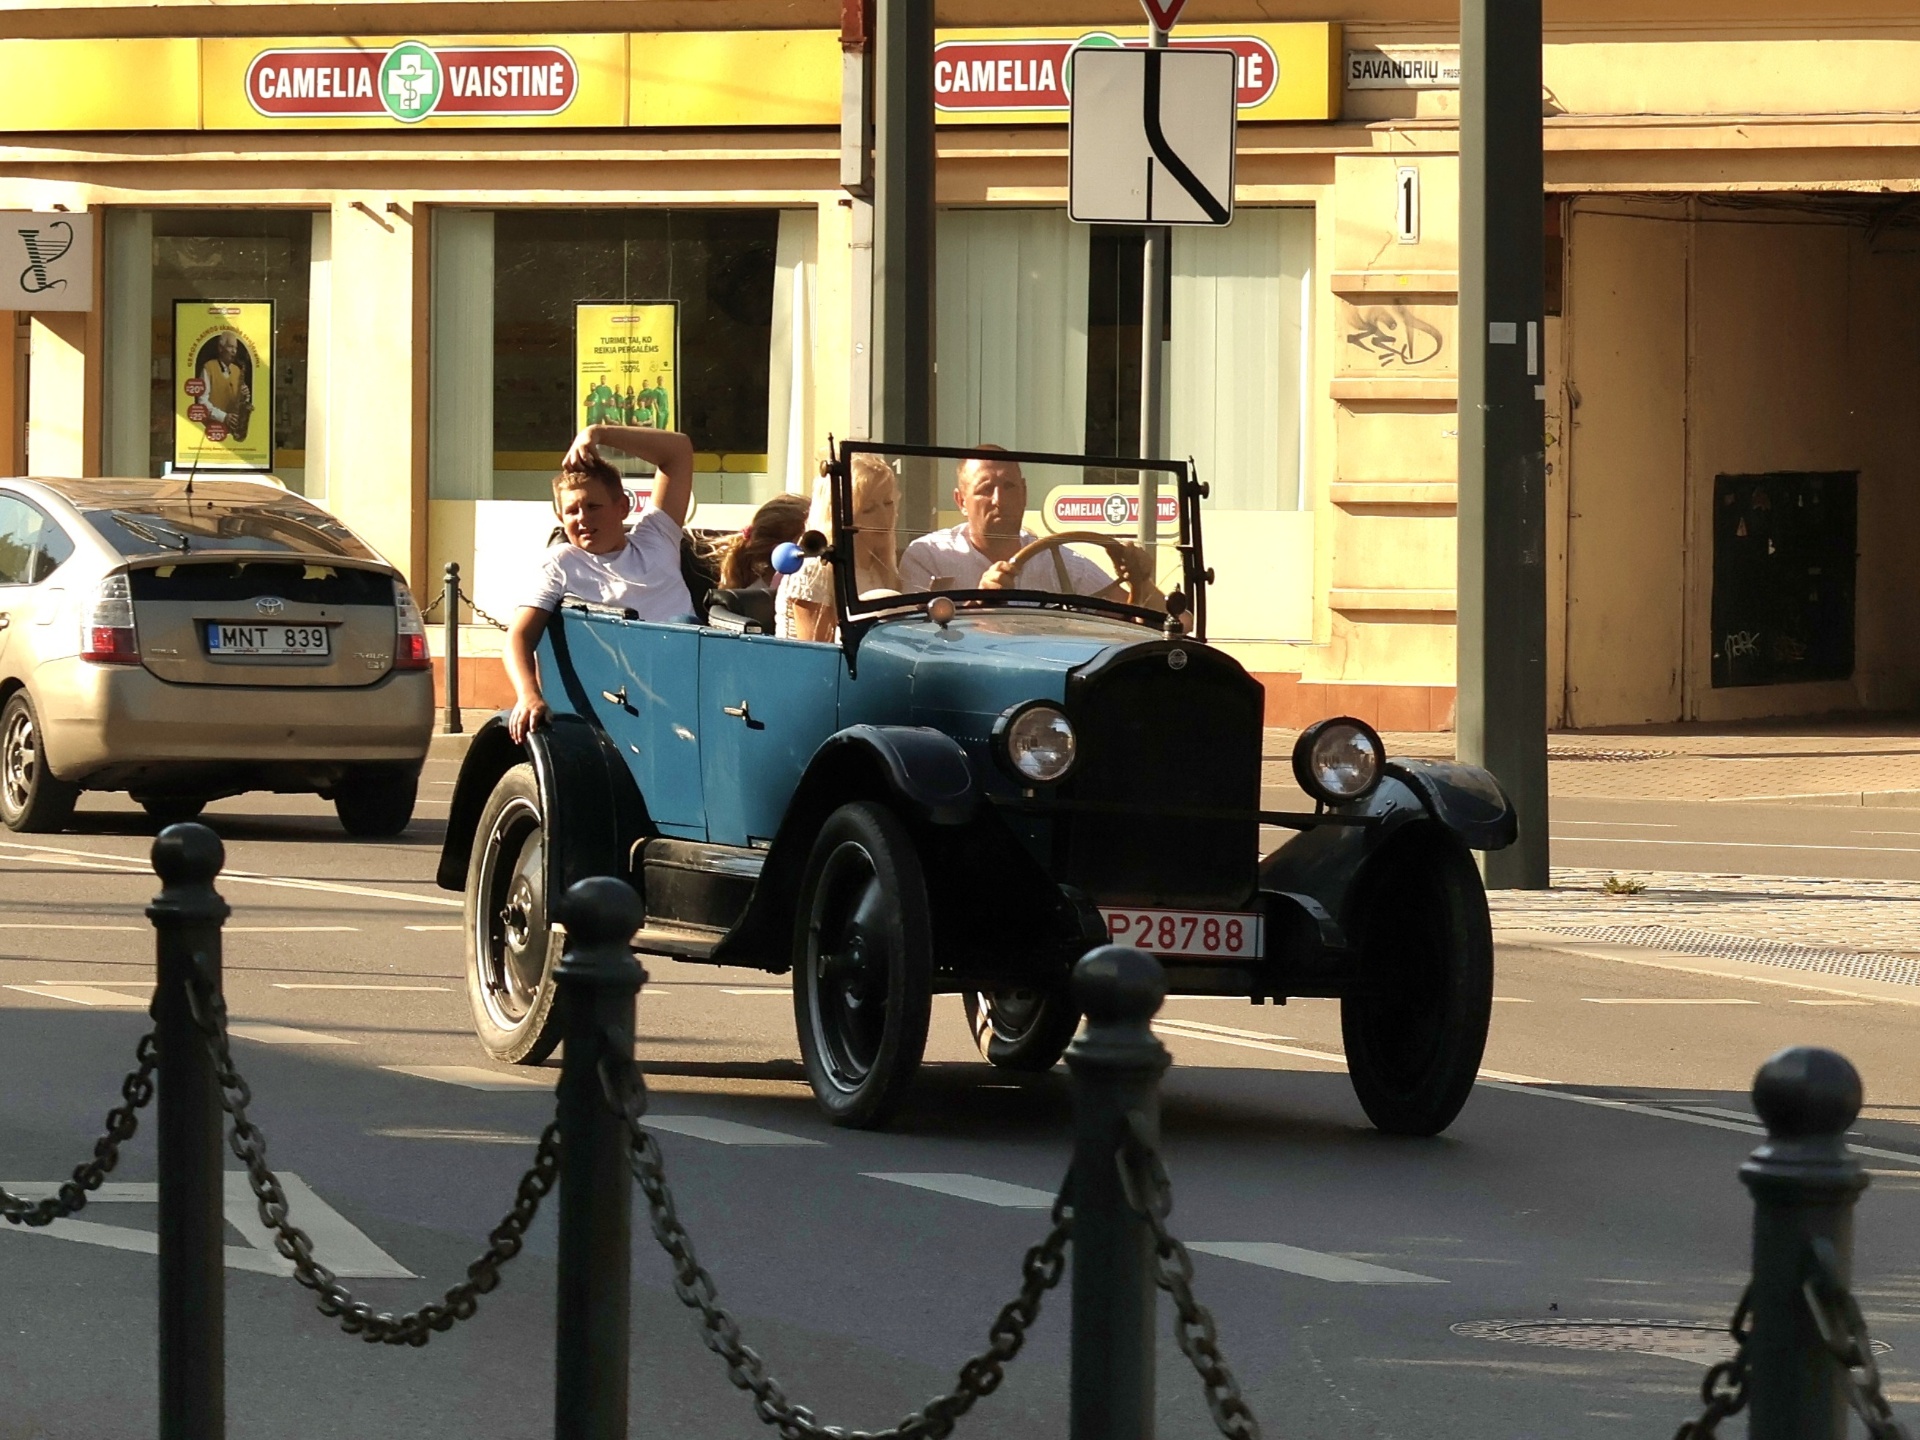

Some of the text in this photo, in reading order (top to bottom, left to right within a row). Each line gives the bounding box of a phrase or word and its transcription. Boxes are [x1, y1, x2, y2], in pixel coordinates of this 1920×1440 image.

[258, 62, 564, 99] CAMELIA VAISTINĖ
[934, 59, 1057, 93] CAMELIA
[1352, 60, 1439, 83] SAVANORIŲ
[1403, 177, 1412, 234] 1
[1057, 503, 1102, 516] CAMELIA
[222, 627, 323, 648] MNT 839
[1107, 913, 1243, 952] P28788
